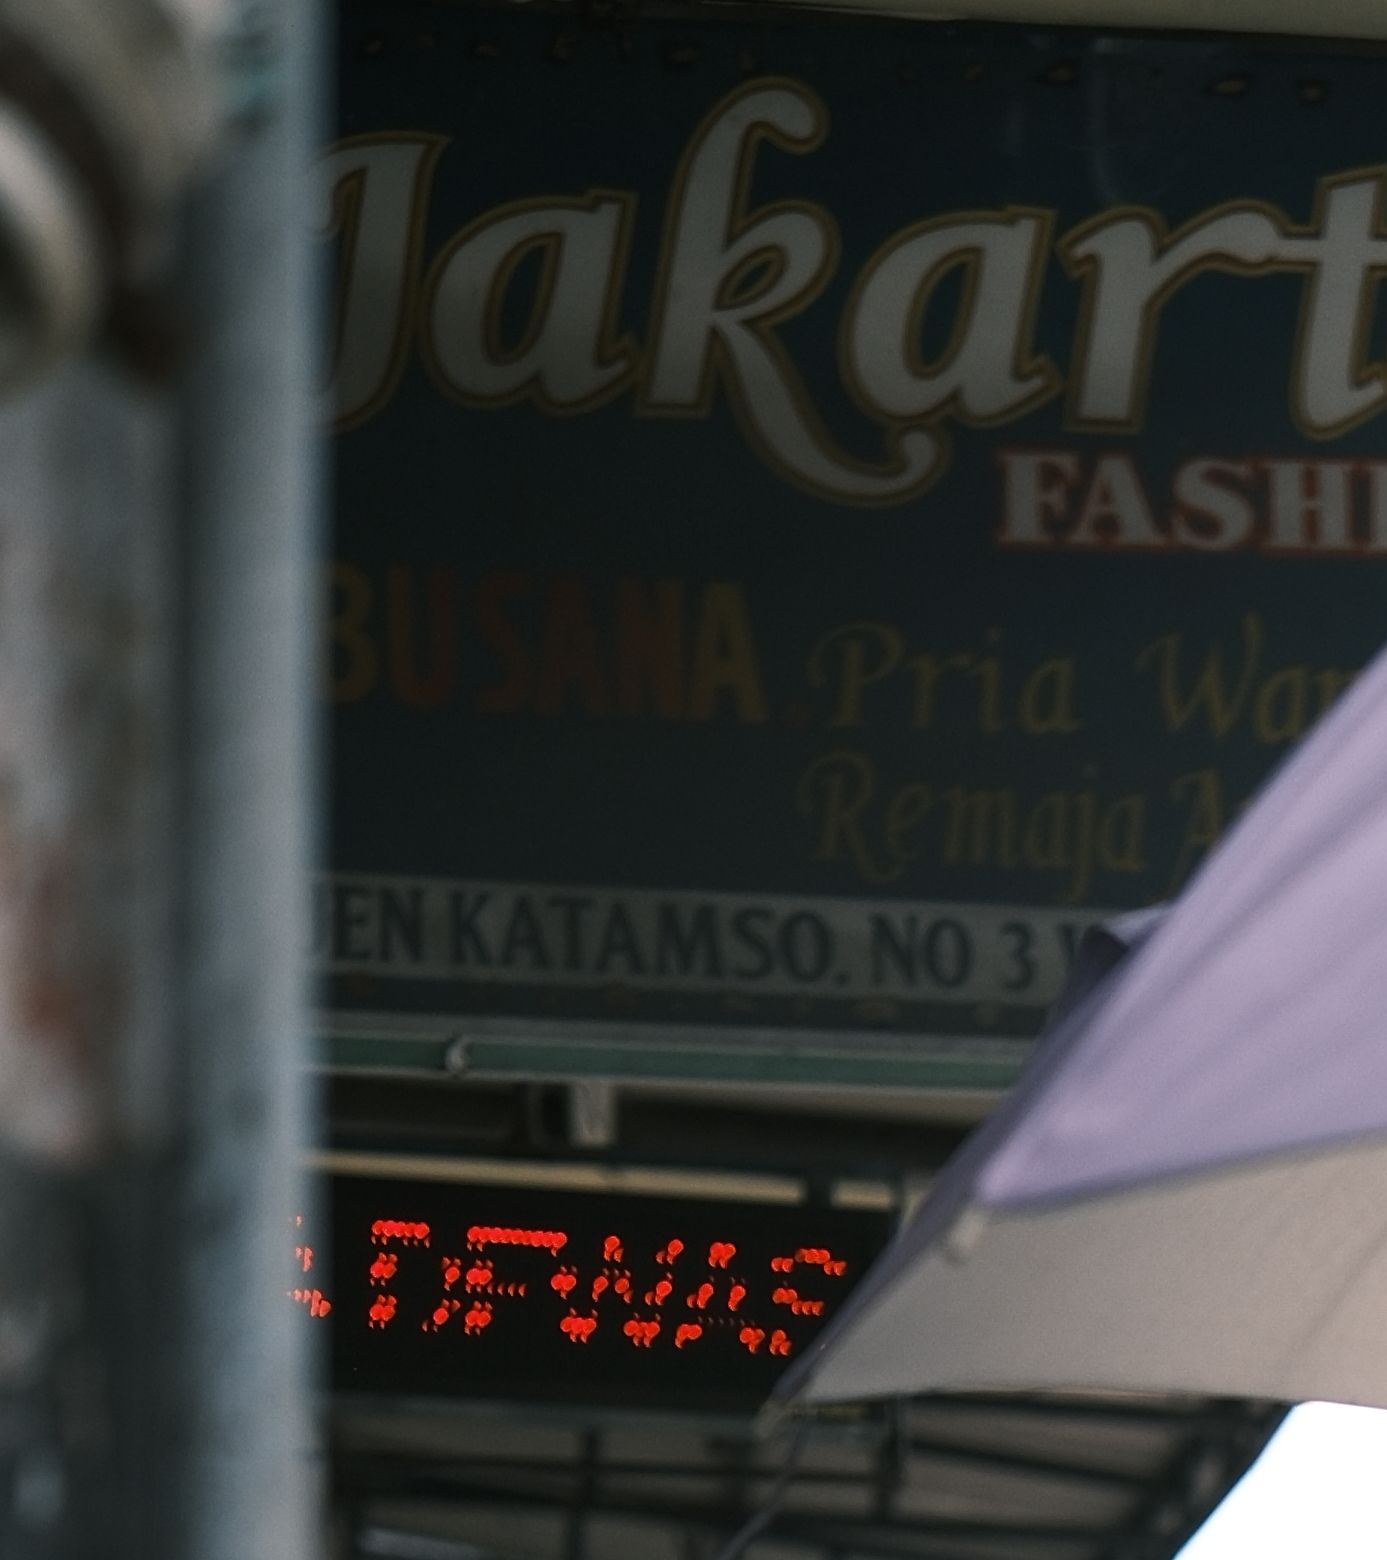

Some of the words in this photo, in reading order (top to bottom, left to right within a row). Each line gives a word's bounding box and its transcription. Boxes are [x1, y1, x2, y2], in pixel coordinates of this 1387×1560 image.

[804, 617, 1082, 735] Pria
[795, 748, 1150, 907] Remaja
[872, 913, 970, 988] NO
[999, 921, 1034, 991] 3
